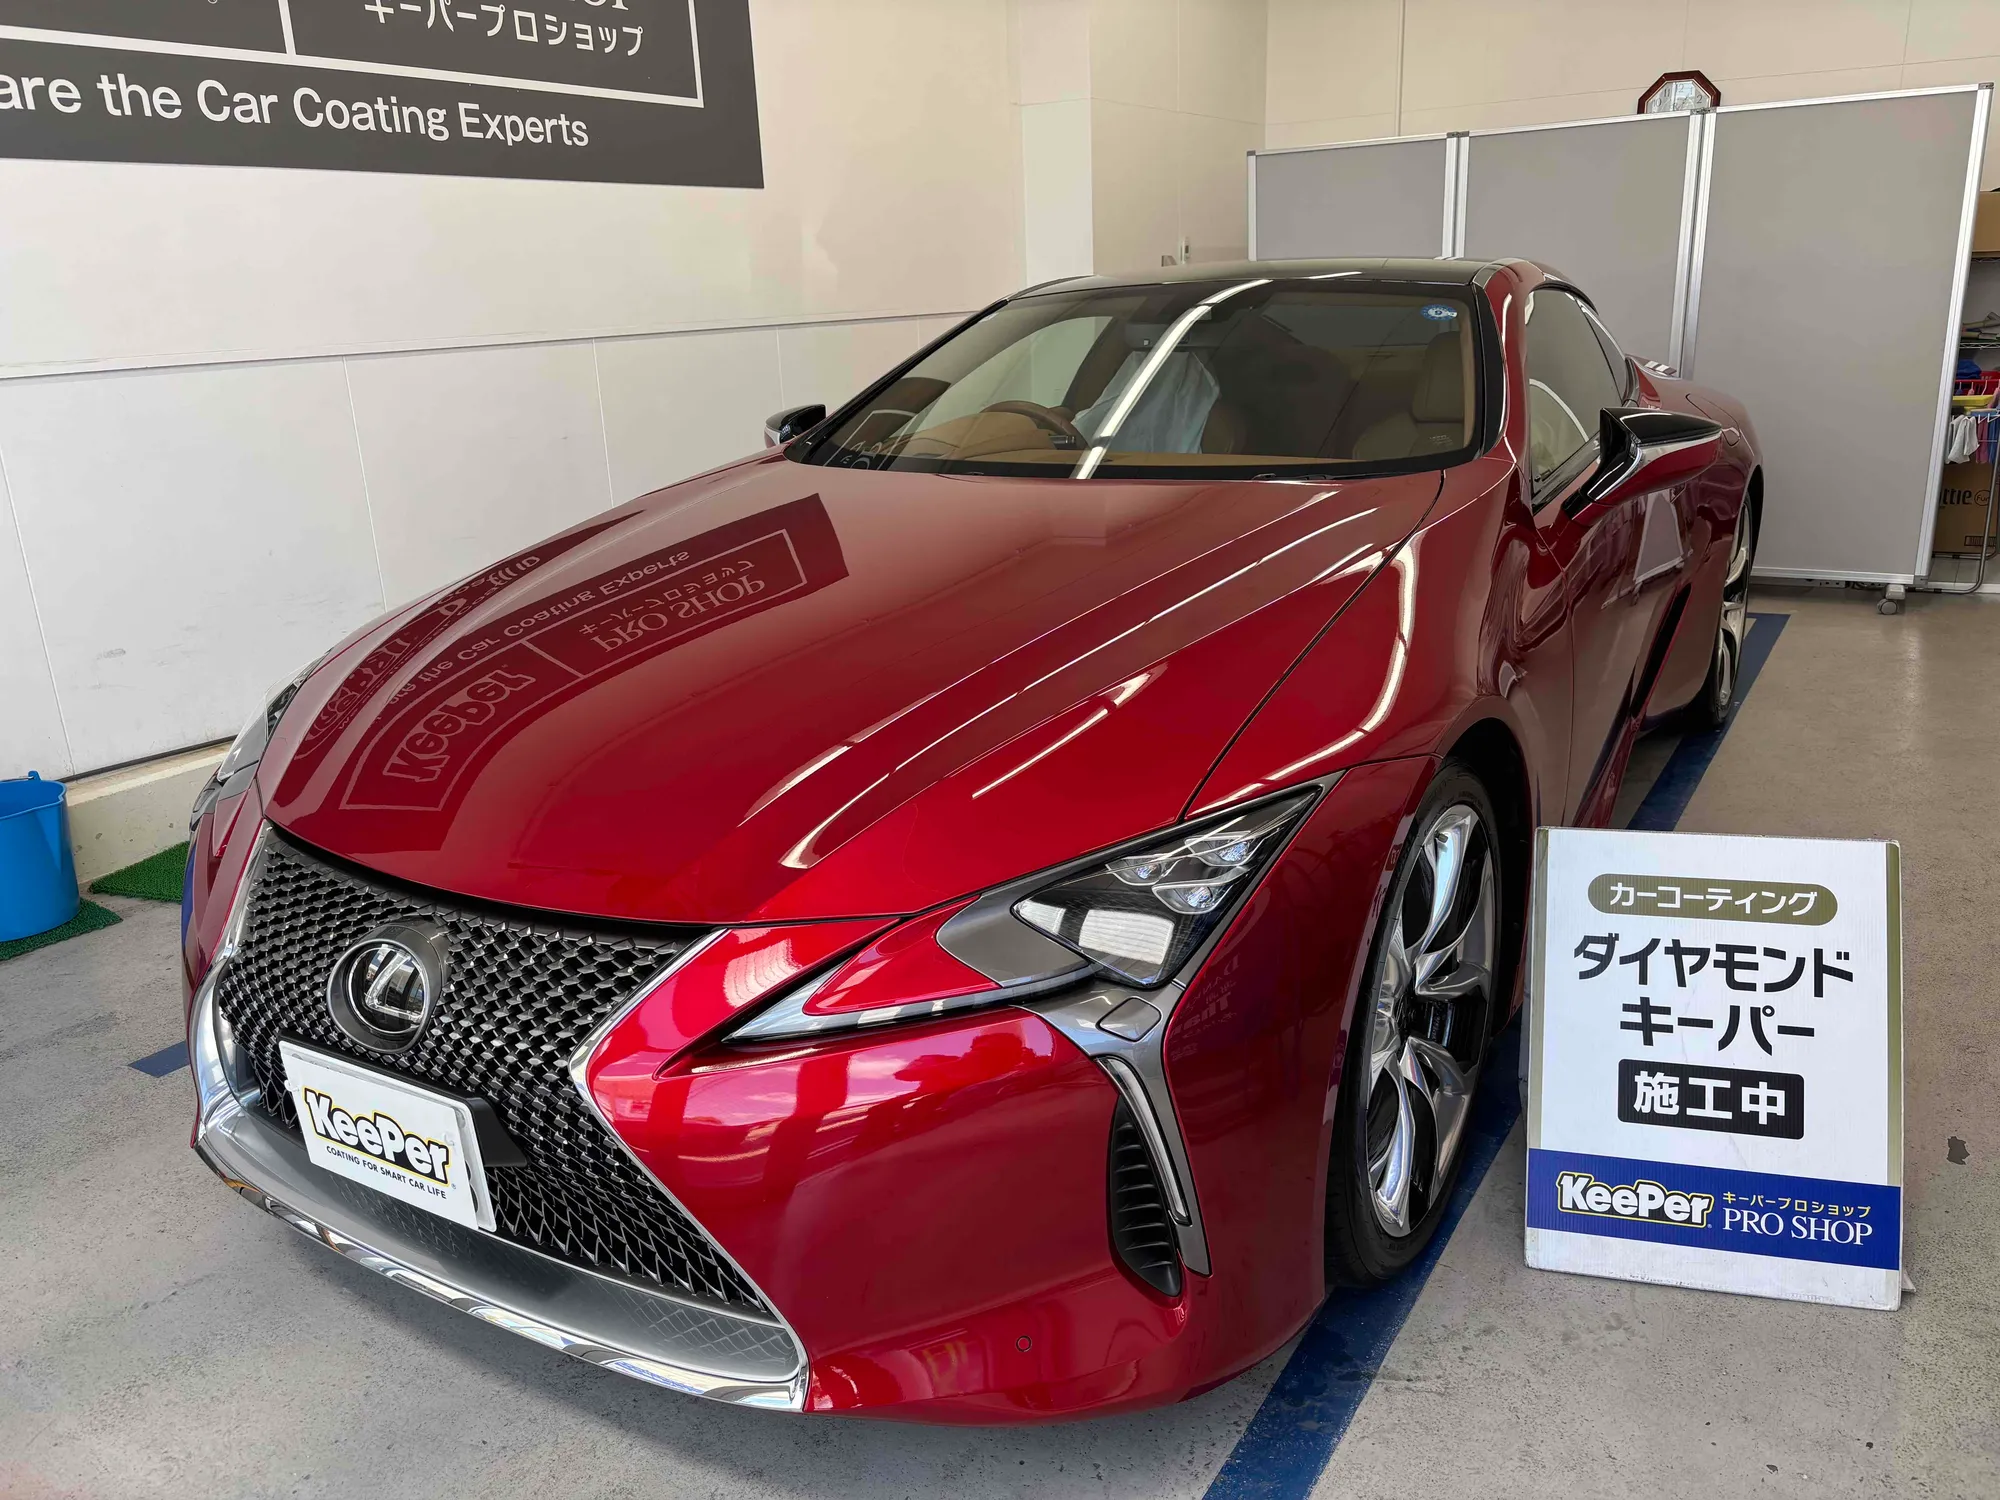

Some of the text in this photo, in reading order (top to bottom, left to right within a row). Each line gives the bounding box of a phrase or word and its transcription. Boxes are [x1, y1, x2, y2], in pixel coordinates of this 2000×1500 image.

[0, 73, 589, 147] are the Car Coating Experts
[1610, 882, 1817, 916] カーコーティング
[1573, 932, 1853, 998] ダイヤモンド
[1620, 996, 1815, 1056] キーパー
[1633, 1070, 1786, 1125] 施工中
[304, 1087, 450, 1185] KeePer
[326, 1145, 447, 1199] COATING FOR SMART CAR LIFE
[1556, 1171, 1714, 1228] KeePer
[1722, 1191, 1872, 1218] キーパープロショップ
[1722, 1207, 1873, 1246] PRO SHOP
